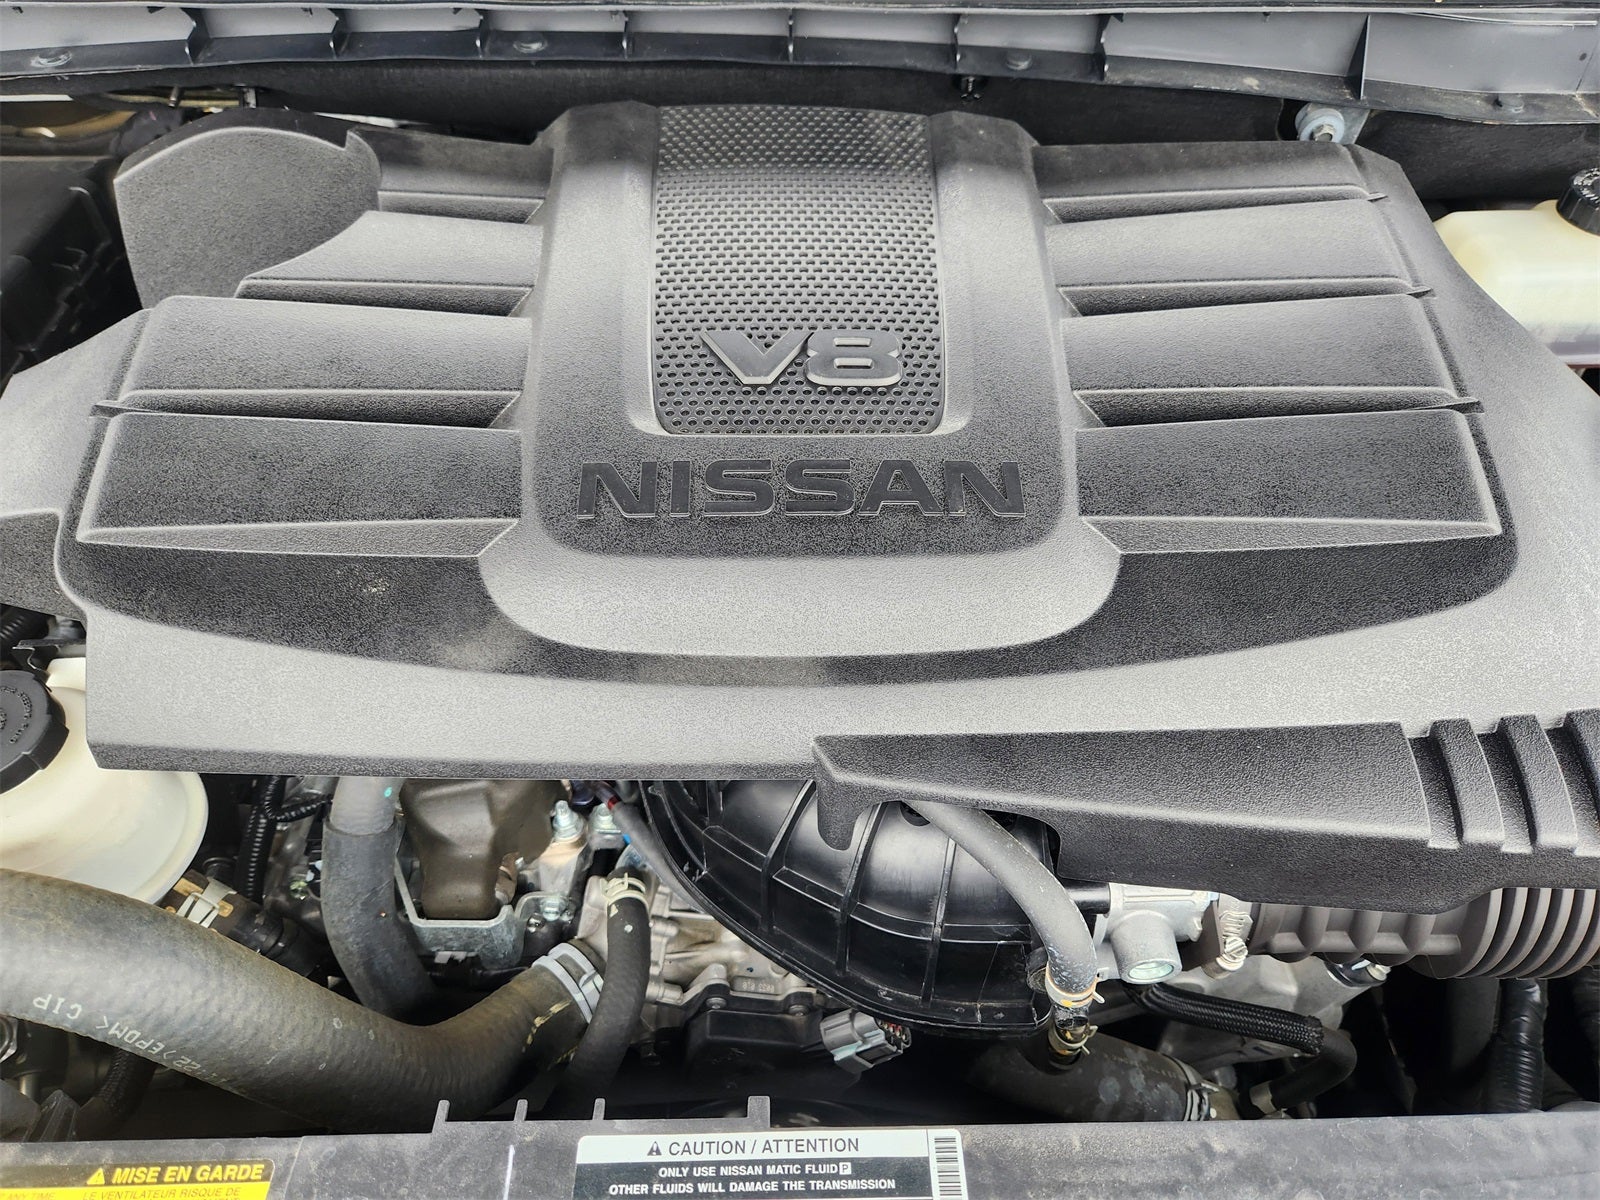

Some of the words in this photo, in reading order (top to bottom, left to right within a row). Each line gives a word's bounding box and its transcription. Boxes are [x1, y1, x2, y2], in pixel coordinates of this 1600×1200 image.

[700, 328, 903, 387] V8
[577, 458, 1026, 519] NISSAN
[668, 1140, 747, 1156] CAUTION
[761, 1137, 860, 1153] ATTENTION
[112, 1166, 161, 1184] MISE
[163, 1165, 191, 1183] EN
[195, 1164, 265, 1181] GARDE
[658, 1167, 690, 1178] ONLY
[693, 1166, 716, 1177] USE
[719, 1165, 762, 1176] NISSAN
[766, 1164, 801, 1175] MATIC
[101, 1188, 177, 1200] VENTILATEUR
[180, 1187, 223, 1198] RISQUE
[225, 1186, 241, 1197] DE
[609, 1184, 649, 1195] OTHER
[652, 1183, 694, 1194] FLUIDS
[697, 1182, 725, 1193] WILL
[729, 1181, 779, 1192] DAMAGE
[782, 1180, 806, 1191] THE
[810, 1179, 896, 1190] TRANSMISSION
